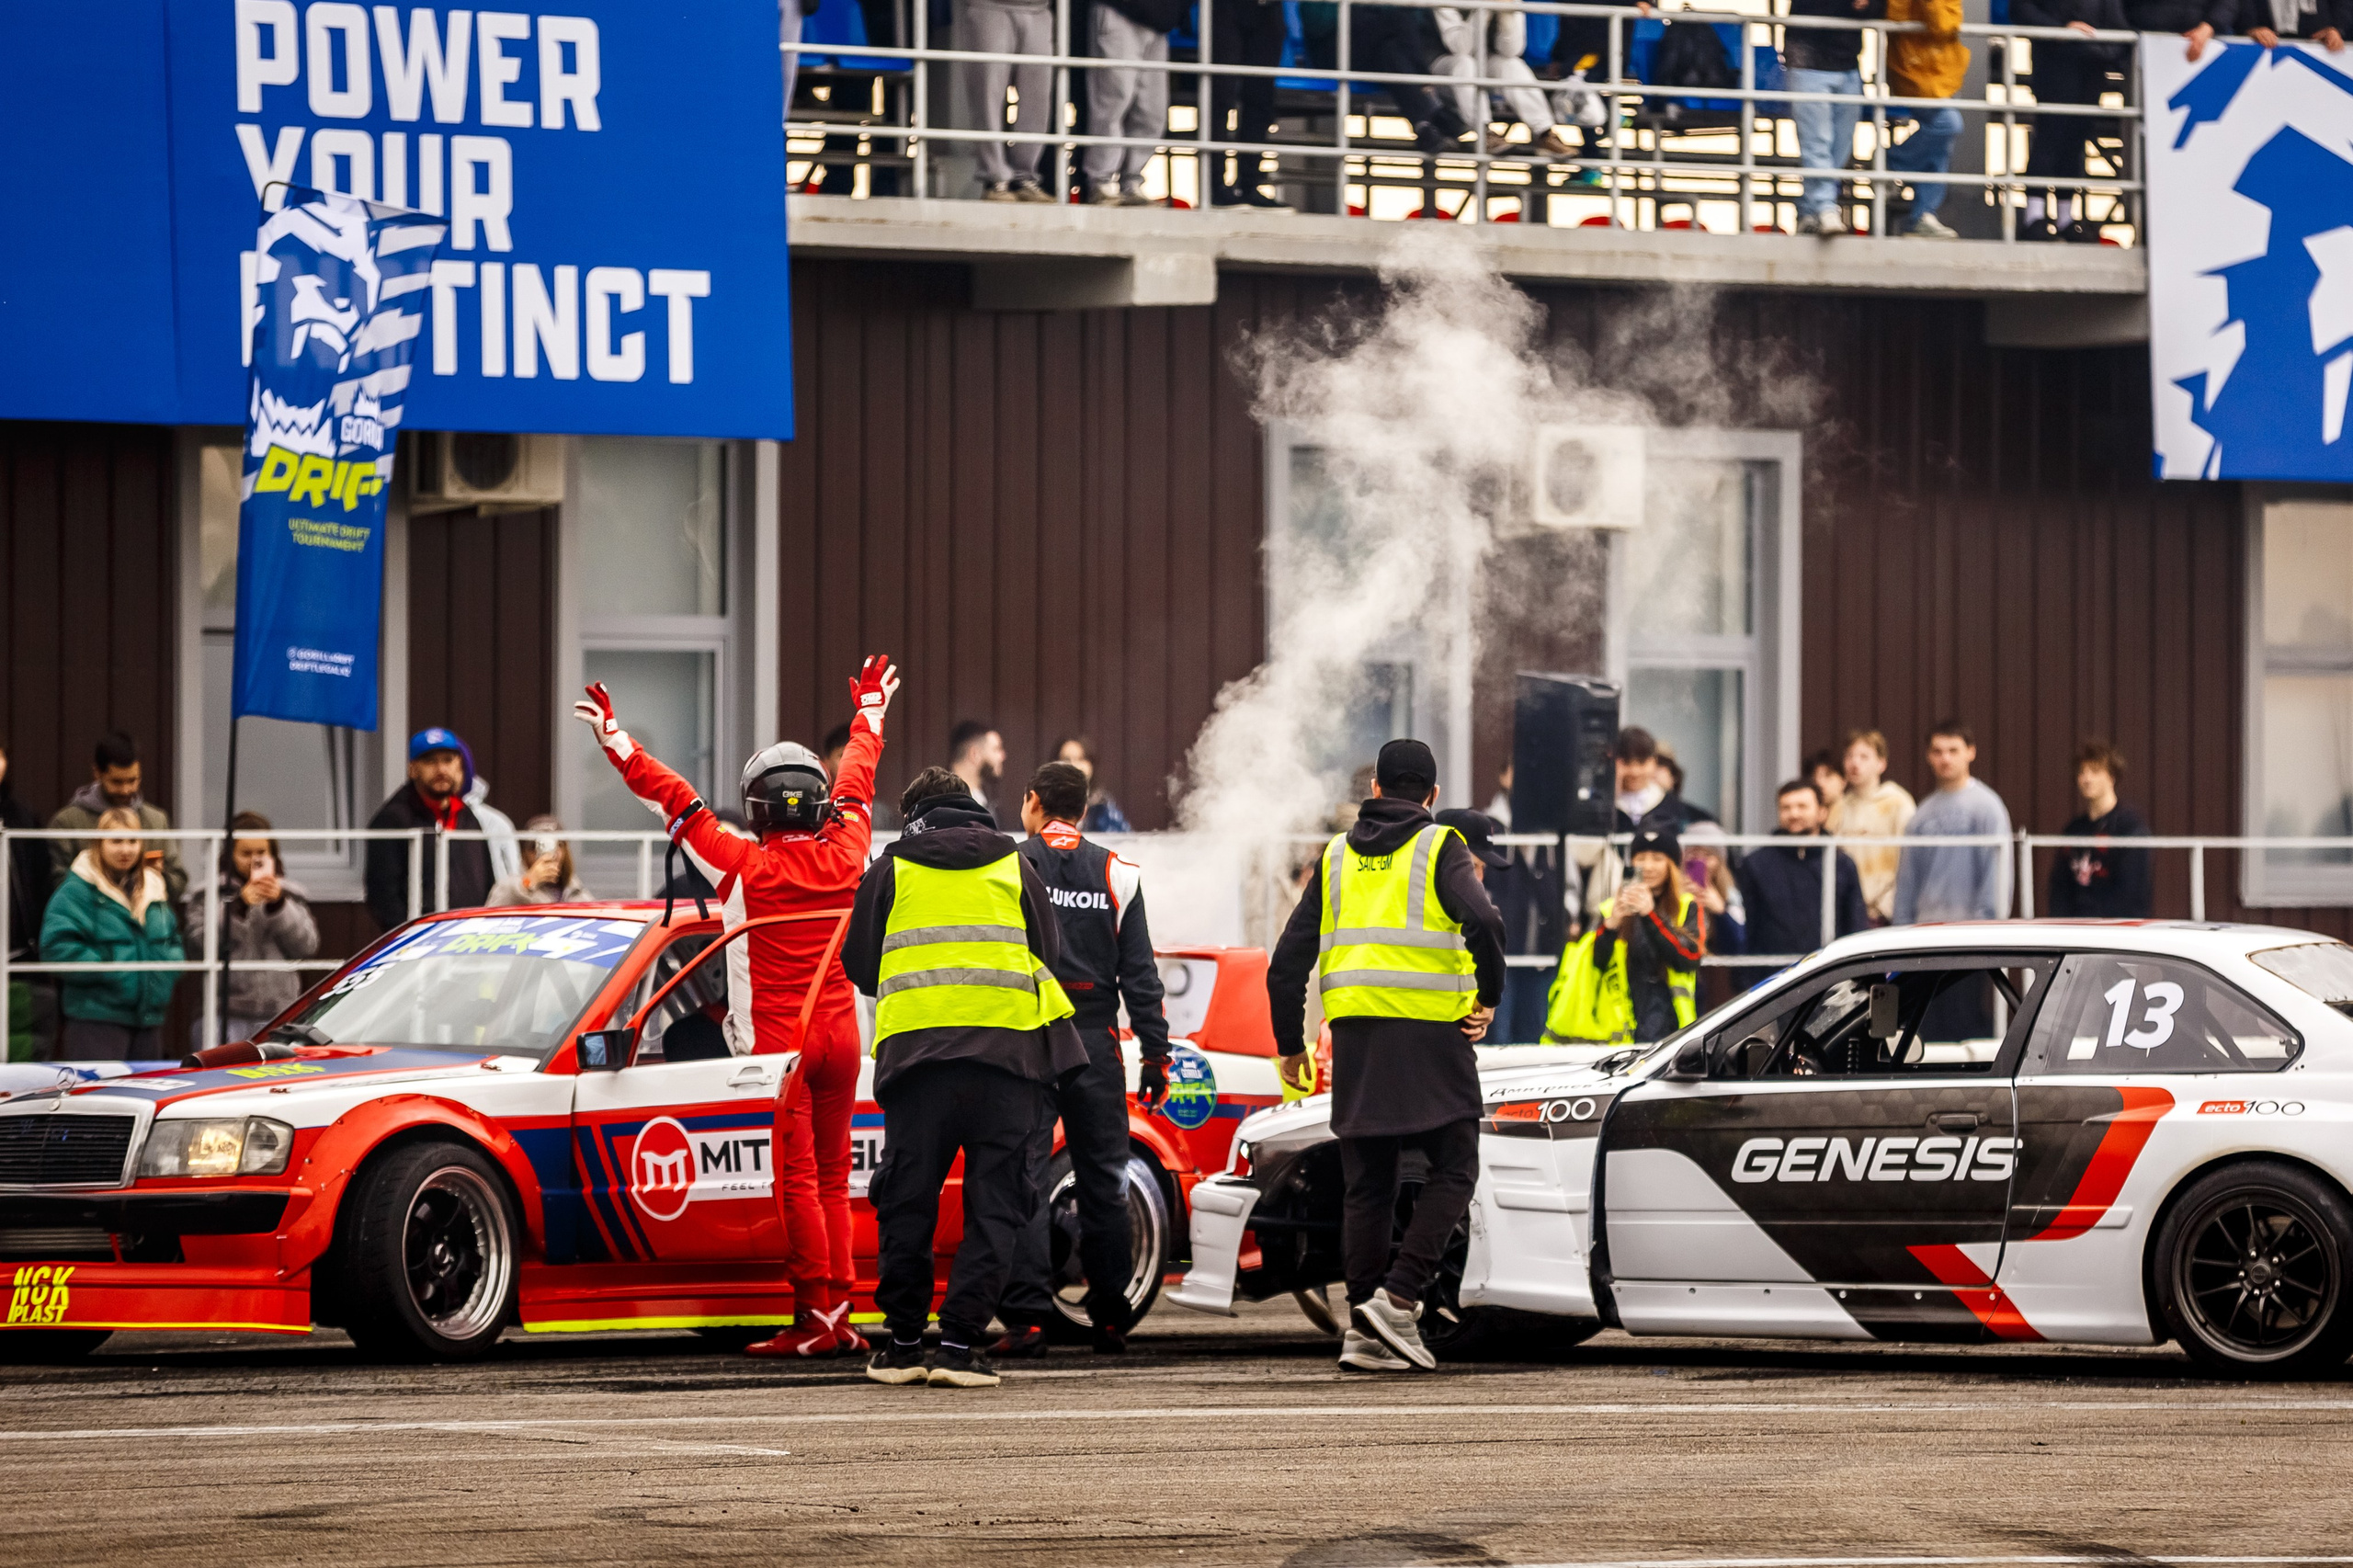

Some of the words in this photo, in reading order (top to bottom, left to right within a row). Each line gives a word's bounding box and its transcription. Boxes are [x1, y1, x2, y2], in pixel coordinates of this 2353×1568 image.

[235, 0, 601, 131] POWER
[2104, 979, 2185, 1050] 13
[1731, 1136, 2023, 1183] GENESIS
